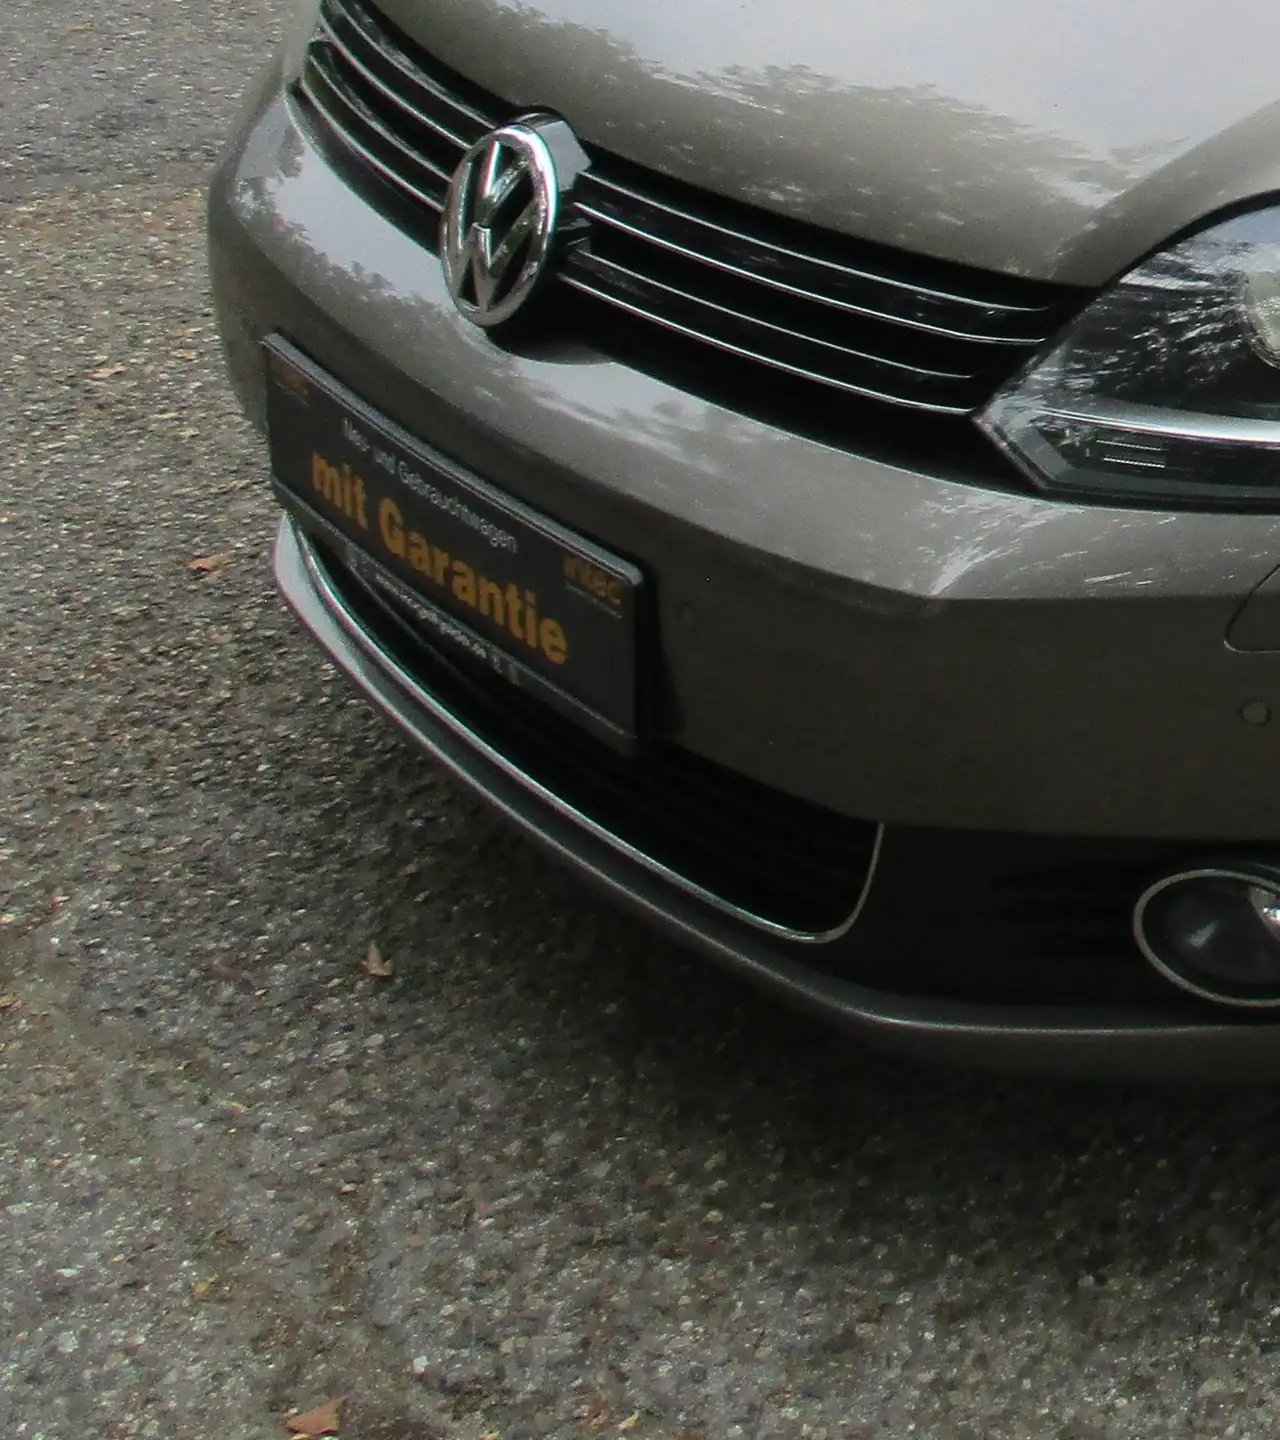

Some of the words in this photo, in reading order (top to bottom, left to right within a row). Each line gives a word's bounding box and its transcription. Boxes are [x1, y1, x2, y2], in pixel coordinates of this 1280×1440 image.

[311, 451, 368, 530] mit
[378, 498, 569, 665] Garantie
[398, 460, 518, 554] Gebrauchtwagen
